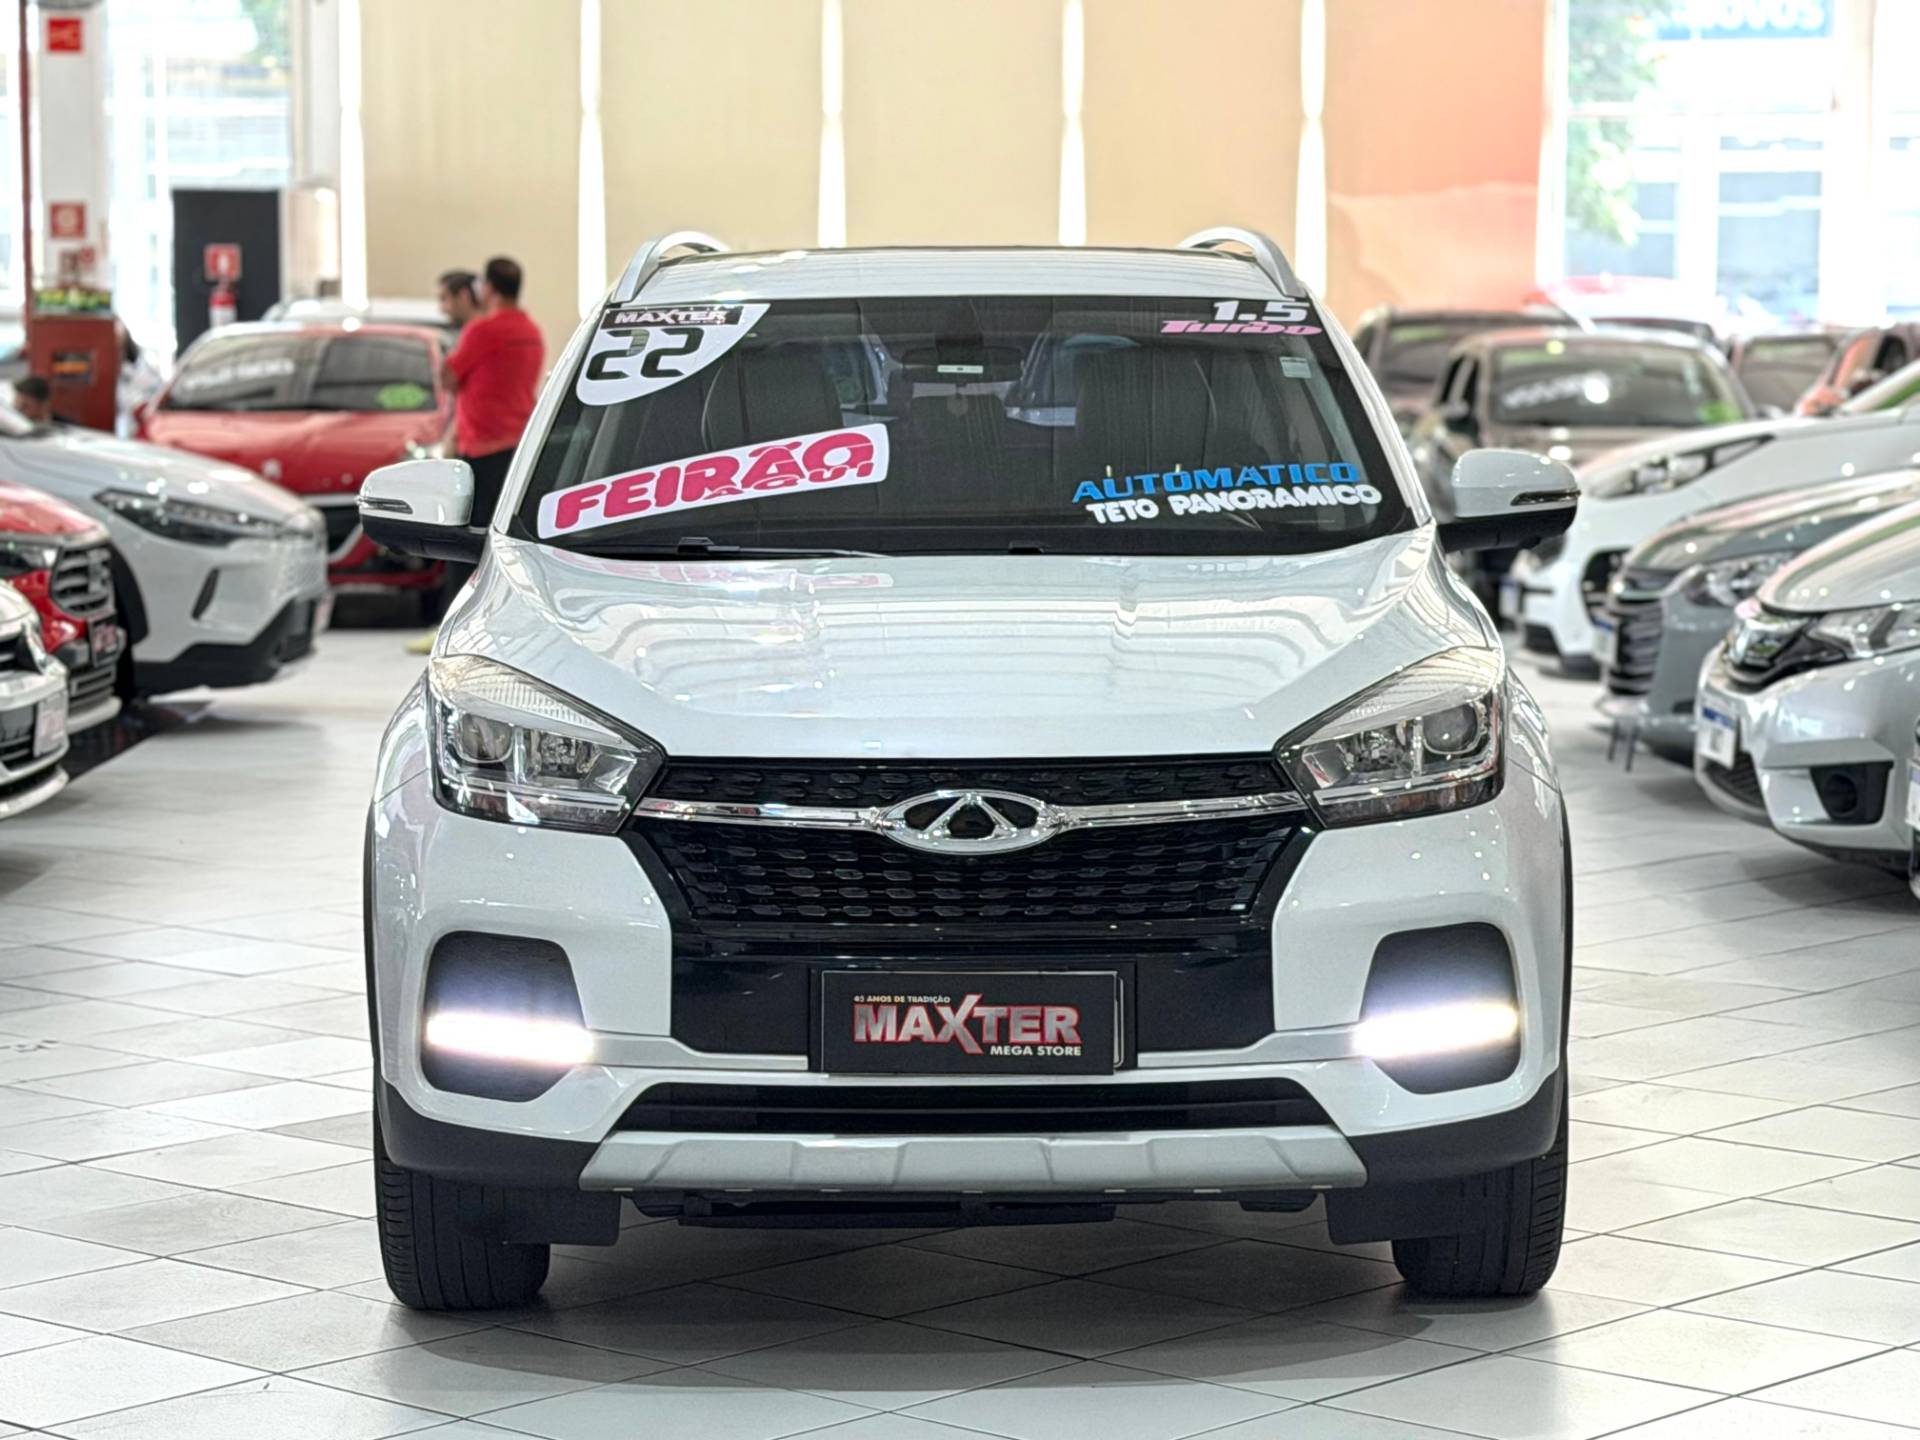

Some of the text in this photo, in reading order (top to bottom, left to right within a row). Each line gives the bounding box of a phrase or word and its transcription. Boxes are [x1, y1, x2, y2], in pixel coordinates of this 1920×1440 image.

[614, 308, 728, 326] MAXTER
[1212, 300, 1311, 323] 1.5
[1160, 319, 1323, 336] Turbo
[586, 327, 705, 382] 22
[554, 432, 874, 530] FEIRÃO
[1085, 498, 1160, 524] TETO
[1167, 484, 1383, 516] PANORAMICO
[866, 994, 892, 1003] ANOS
[893, 994, 905, 1003] DE
[853, 992, 1082, 1055] MAXTER
[990, 1045, 1082, 1056] MEGA STORE
